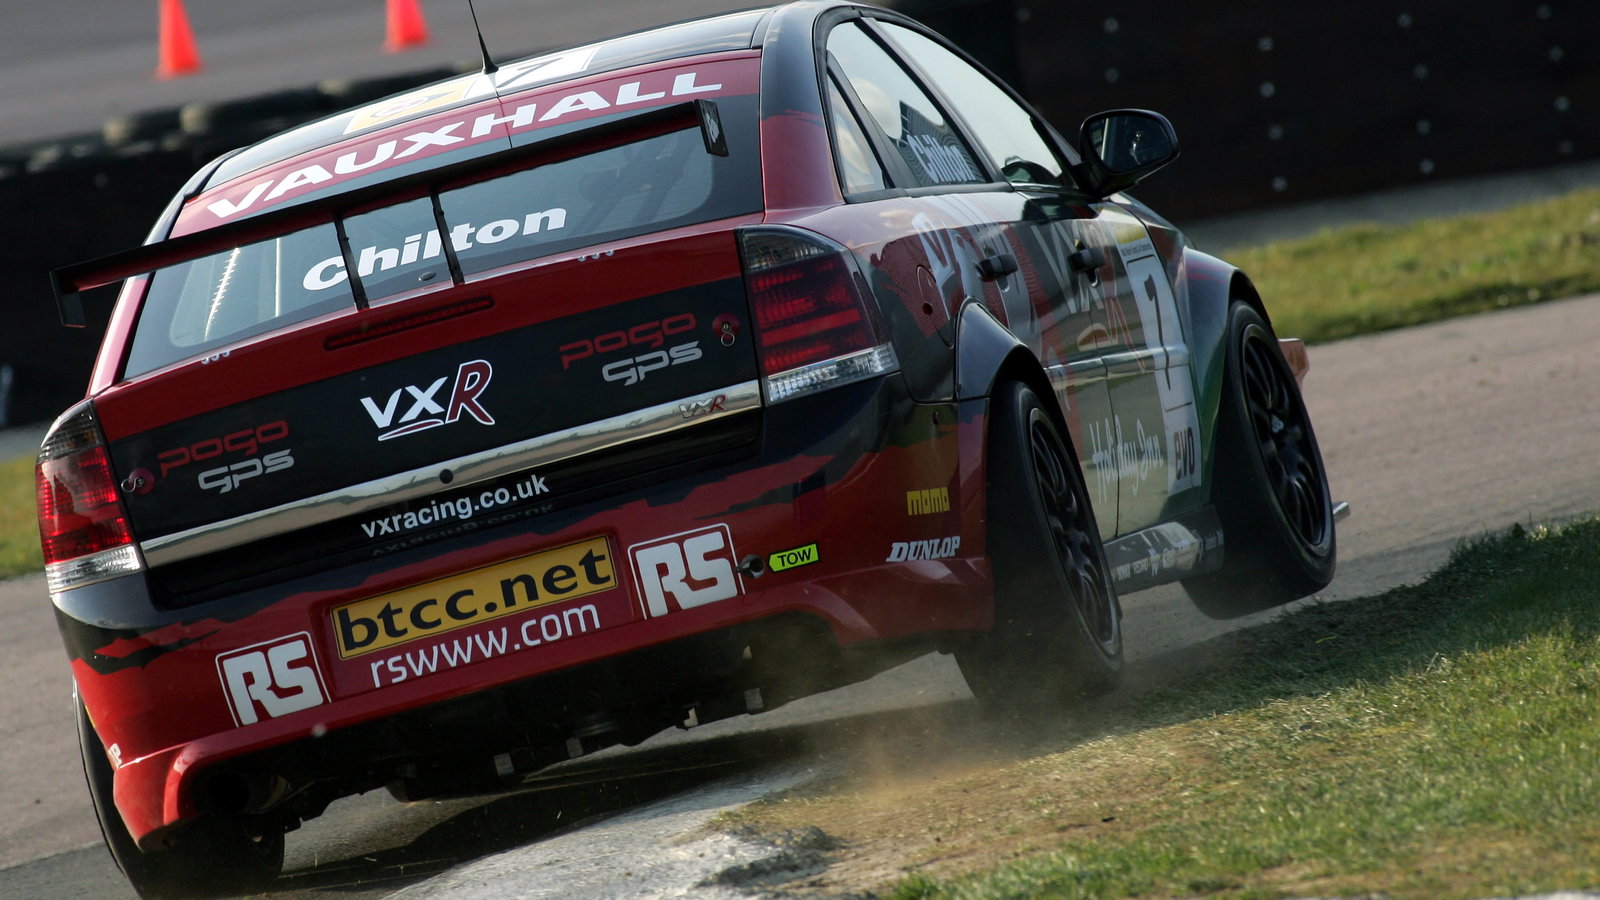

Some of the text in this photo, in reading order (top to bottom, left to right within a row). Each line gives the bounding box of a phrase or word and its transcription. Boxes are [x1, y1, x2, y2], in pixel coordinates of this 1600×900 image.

[206, 72, 722, 218] VAUXHALL
[906, 133, 976, 184] Chilton
[303, 207, 567, 291] Chilton
[360, 359, 496, 428] VXR
[1090, 413, 1164, 504] Holiday Inn
[361, 474, 550, 539] vxracing.co.uk
[635, 530, 738, 618] RS
[777, 547, 812, 566] TOW
[885, 536, 960, 563] DUNLOP
[337, 548, 612, 651] btcc.net
[222, 639, 323, 725] RS
[370, 603, 601, 689] rswww.com
